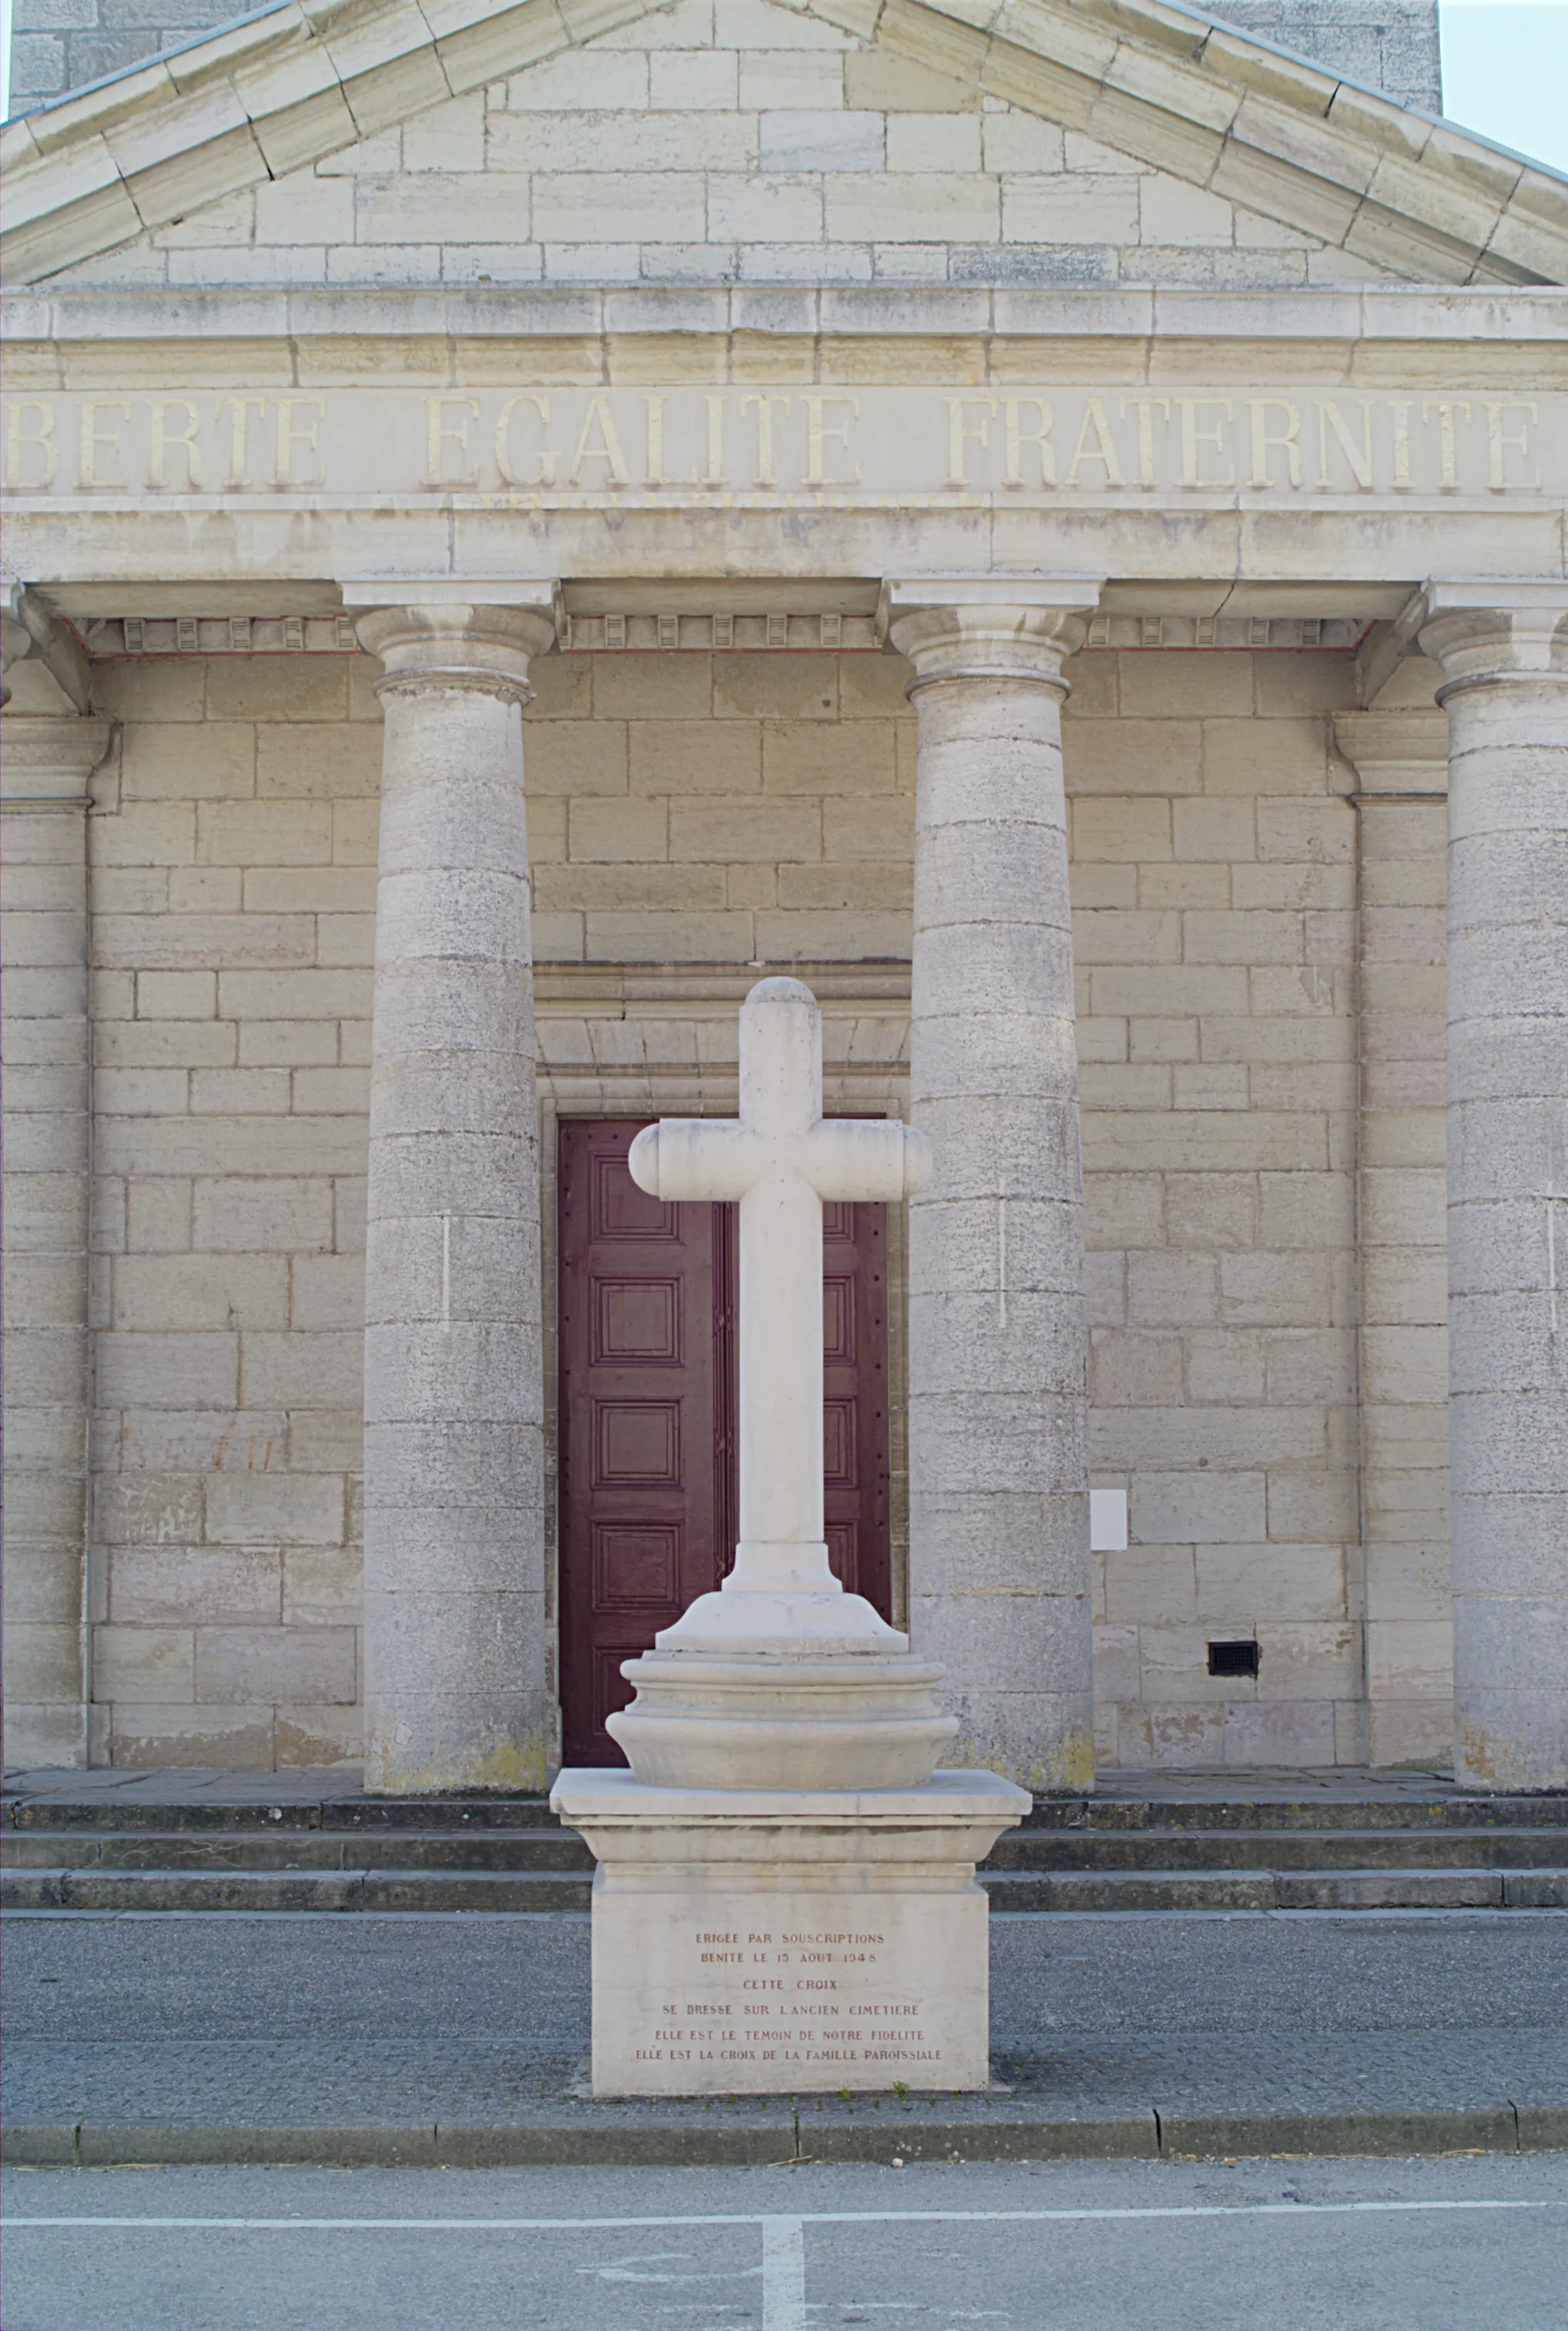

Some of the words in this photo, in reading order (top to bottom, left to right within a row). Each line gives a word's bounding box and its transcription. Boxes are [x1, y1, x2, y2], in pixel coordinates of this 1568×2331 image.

[420, 394, 862, 487] EGALITE
[942, 396, 1542, 489] FRATERNITE
[695, 1933, 740, 1944] ERIGEE
[748, 1933, 773, 1944] PAR
[781, 1933, 885, 1944] SOUSCRIPTIONS
[700, 1952, 745, 1964] BENITE
[753, 1952, 769, 1964] LE
[776, 1952, 790, 1964] 15
[799, 1952, 833, 1964] AOUT
[843, 1952, 877, 1964] 1948
[742, 1979, 785, 1991] CETTE
[796, 1979, 838, 1991] CROIX
[662, 2004, 678, 2016] SE
[686, 2004, 733, 2016] DRESSE
[742, 2004, 770, 2016] SUR
[779, 2004, 840, 2016] L'ANCIEN
[849, 2004, 920, 2016] CIMETIERE
[655, 2029, 684, 2041] ELLE
[689, 2029, 714, 2041] EST
[721, 2029, 737, 2041] LE
[744, 2029, 792, 2041] TEMOIN
[799, 2029, 816, 2041] DE
[822, 2029, 863, 2041] NOTRE
[870, 2029, 925, 2041] FIDELITE
[635, 2049, 664, 2061] ELLE
[669, 2049, 692, 2061] EST
[699, 2049, 715, 2061] LA
[720, 2049, 757, 2061] CROIX
[762, 2049, 778, 2061] DE
[784, 2049, 801, 2061] LA
[806, 2049, 858, 2061] FAMILLE
[863, 2049, 943, 2061] PAROISSIALE
